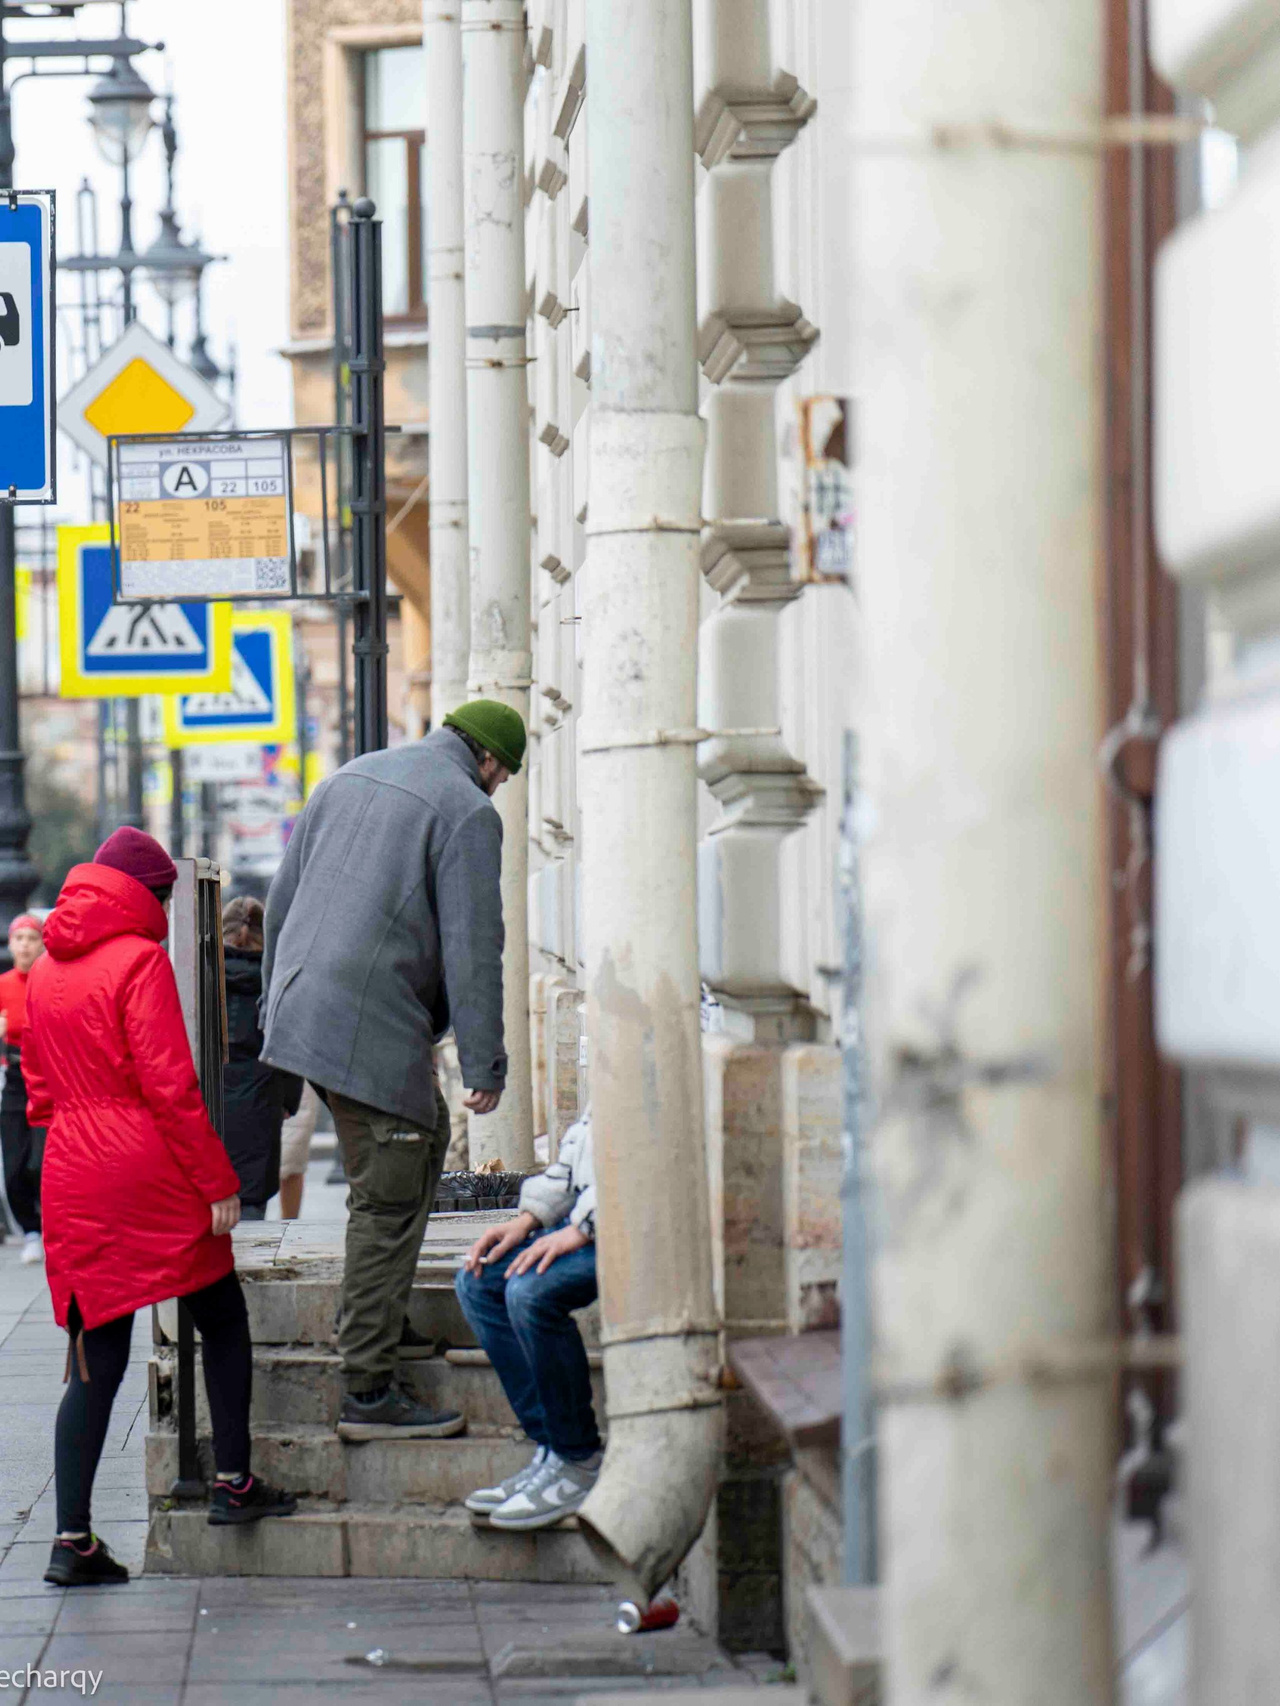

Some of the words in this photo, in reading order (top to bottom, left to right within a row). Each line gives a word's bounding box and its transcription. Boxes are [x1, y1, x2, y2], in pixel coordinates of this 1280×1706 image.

[177, 444, 243, 455] НЕКРАСОВА
[221, 482, 237, 493] 22
[253, 481, 277, 492] 105
[125, 502, 140, 514] 22
[204, 499, 227, 511] 105
